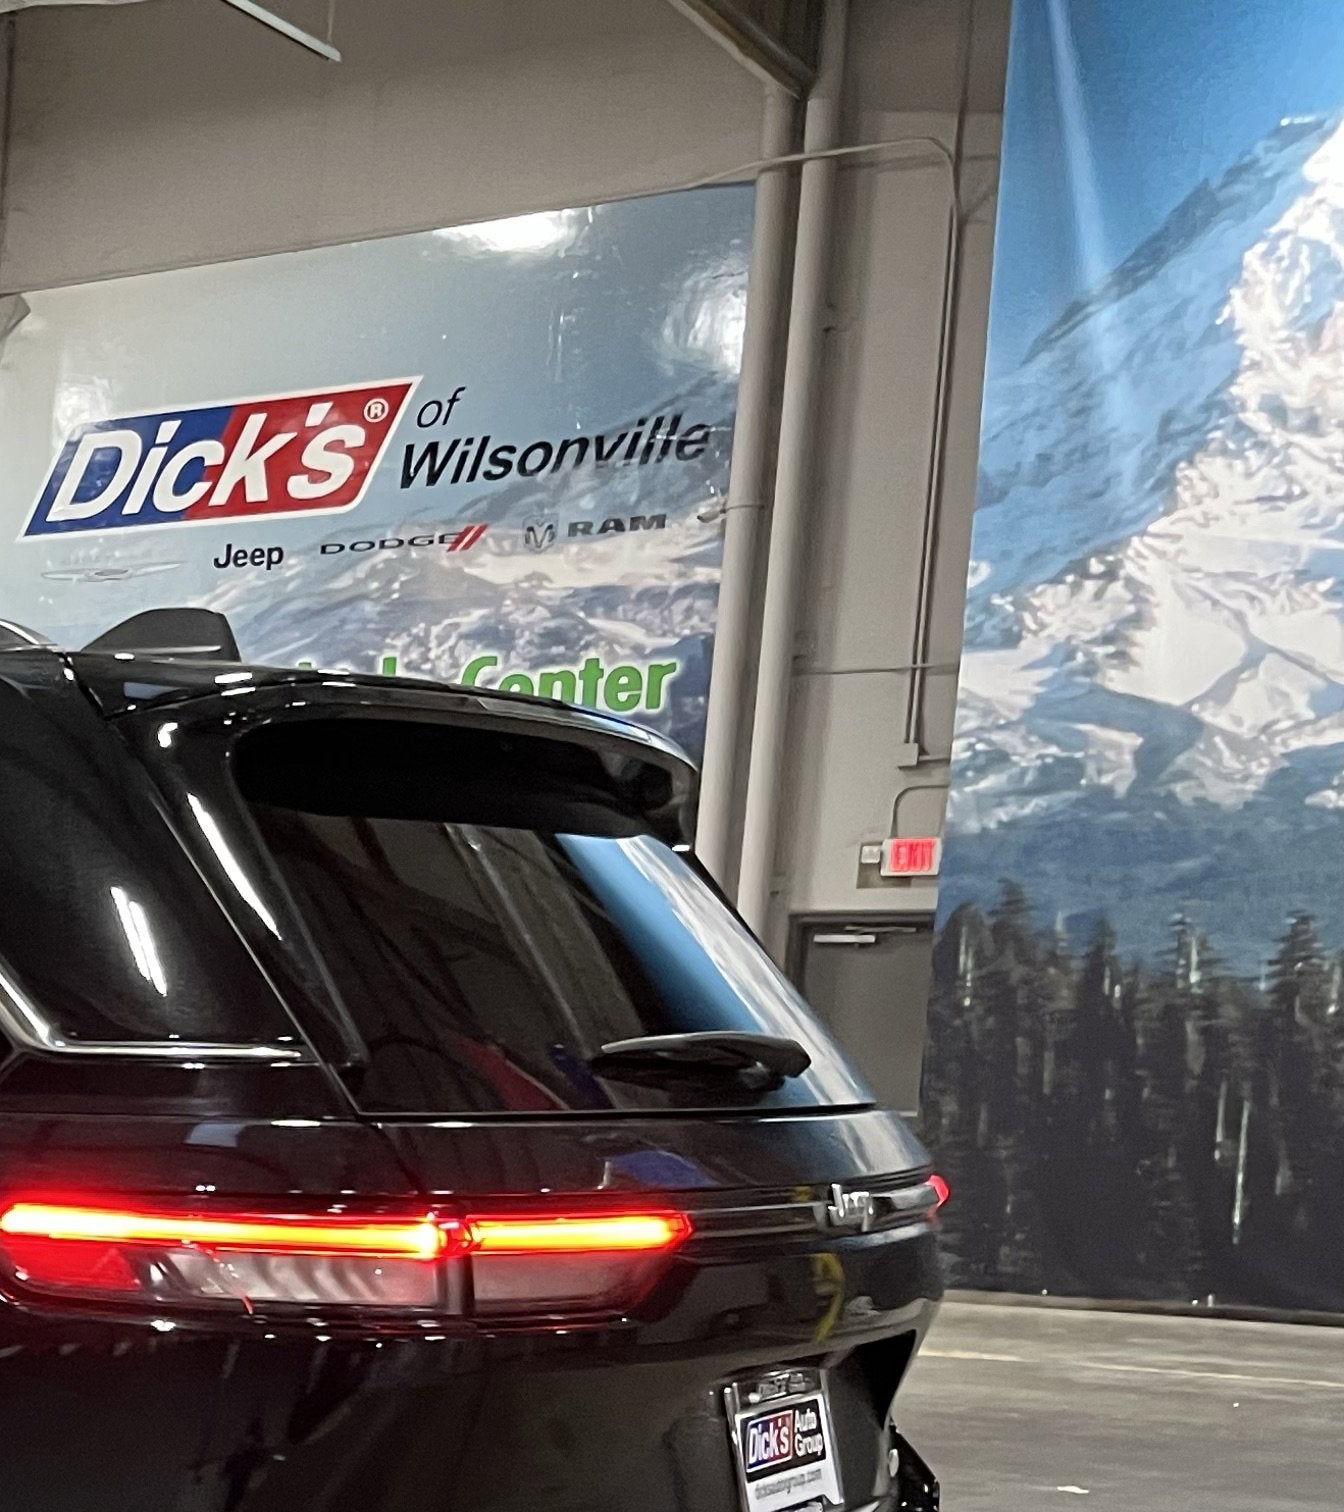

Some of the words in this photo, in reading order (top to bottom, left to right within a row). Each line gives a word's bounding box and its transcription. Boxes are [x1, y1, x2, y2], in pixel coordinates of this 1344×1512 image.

[416, 387, 466, 428] of
[45, 401, 367, 522] Dick's
[400, 413, 711, 489] Wilsonville
[568, 513, 668, 538] RAM
[213, 543, 284, 570] Jeep
[320, 531, 460, 555] DODGE
[891, 840, 935, 872] EXIT
[794, 1407, 818, 1433] Auto
[748, 1417, 790, 1465] Dick's
[794, 1433, 824, 1457] Group
